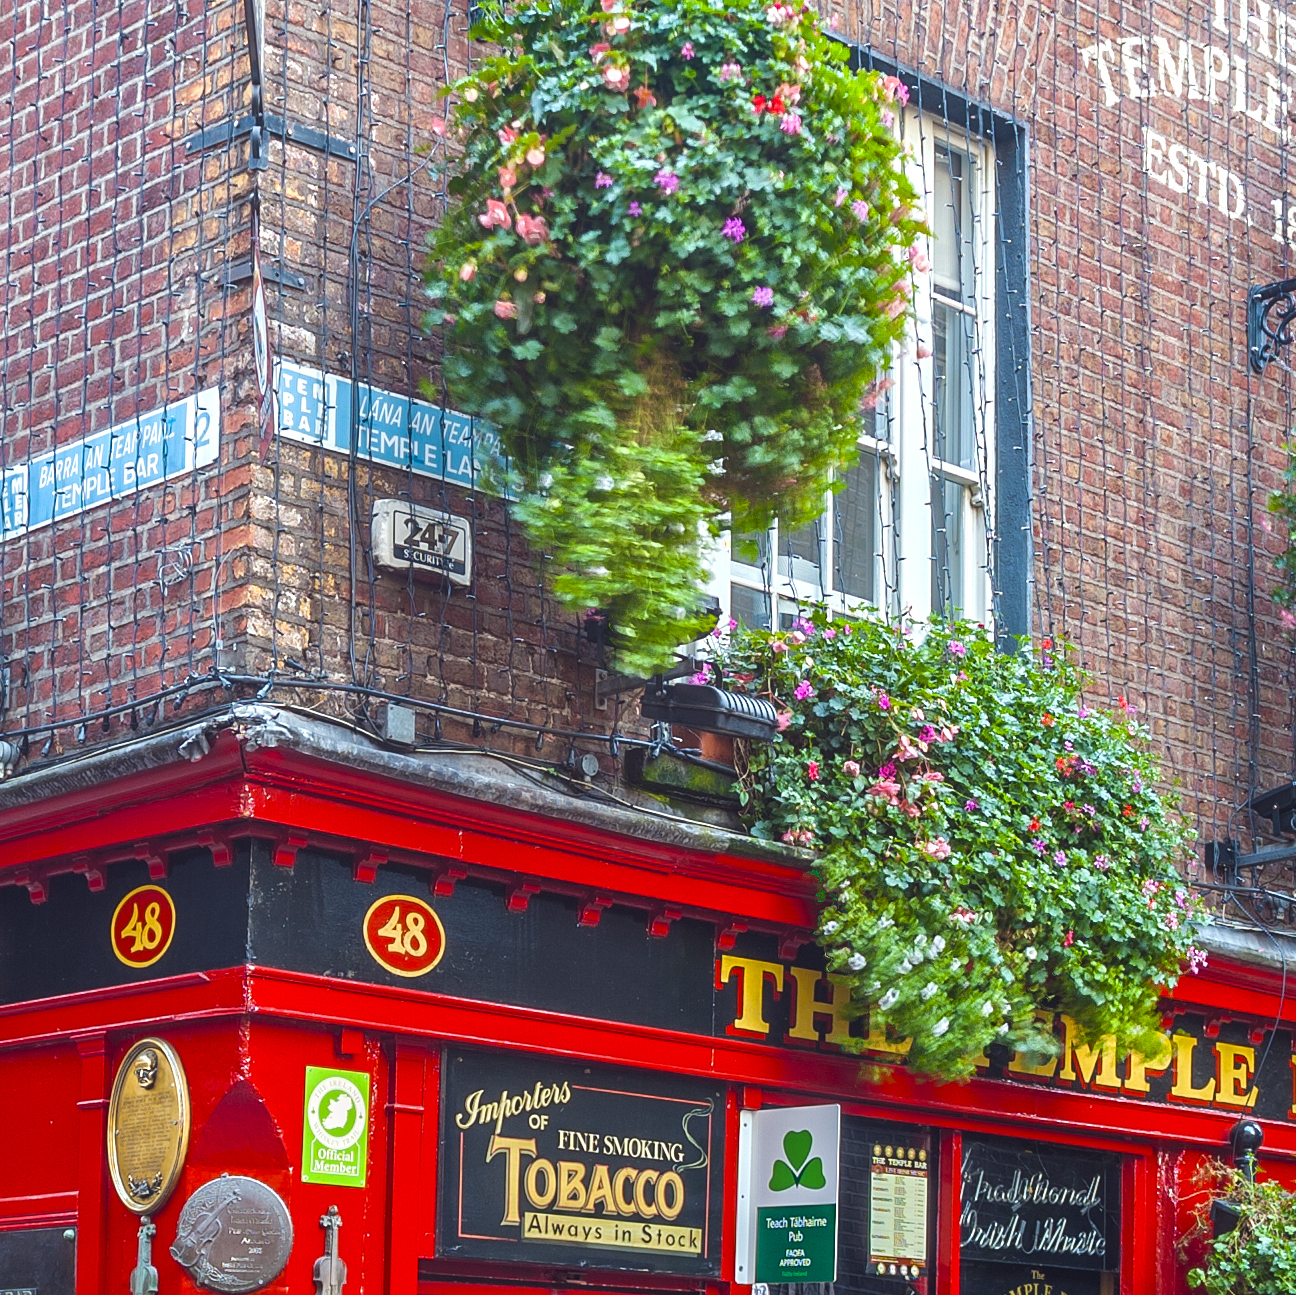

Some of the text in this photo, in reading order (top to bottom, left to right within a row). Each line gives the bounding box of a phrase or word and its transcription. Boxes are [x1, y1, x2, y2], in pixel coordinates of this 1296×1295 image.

[1079, 36, 1294, 145] TEMPLE
[359, 395, 436, 437] LÁNA AN
[39, 412, 211, 489] BARRA AN 2
[355, 424, 438, 468] TEMPLE
[53, 453, 160, 512] TEMPLE BAR
[120, 905, 162, 955] 48
[377, 906, 429, 958] 48
[329, 1080, 361, 1104] IRELAND
[455, 1080, 572, 1135] Importers
[313, 1121, 340, 1147] WHISKEY
[528, 1114, 549, 1131] OF
[317, 1148, 355, 1163] Official
[557, 1129, 686, 1163] FINE SMOKING
[872, 1156, 928, 1170] THE TEMPLE BAR
[313, 1160, 358, 1175] Member
[486, 1134, 685, 1226] TOBACCO
[527, 1214, 698, 1250] Always in Stock
[765, 1217, 788, 1229] Teach
[788, 1229, 804, 1243] Pub
[778, 1258, 812, 1267] APPROVED
[1031, 1269, 1046, 1281] The
